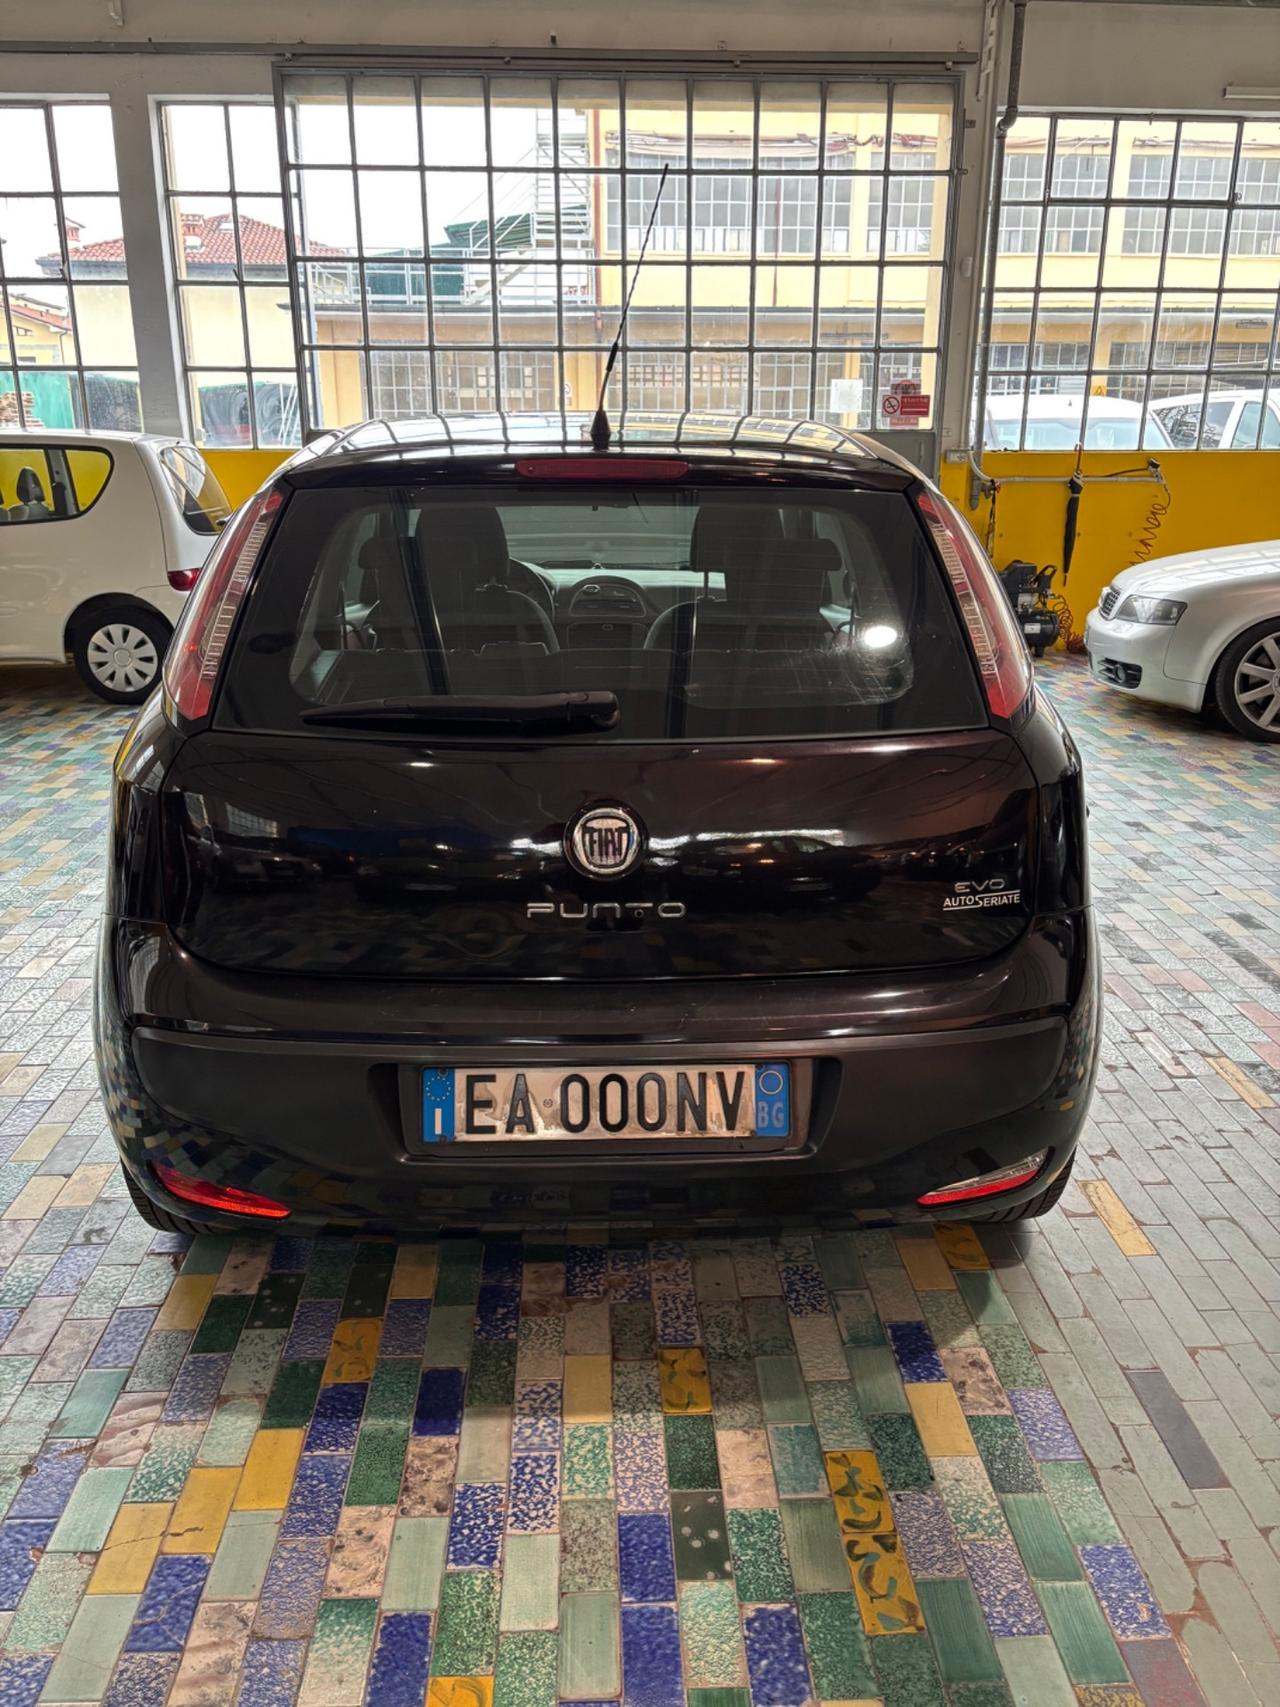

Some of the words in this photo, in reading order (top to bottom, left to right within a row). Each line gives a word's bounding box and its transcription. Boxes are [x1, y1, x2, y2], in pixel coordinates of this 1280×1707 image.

[583, 826, 629, 864] FIAT
[954, 879, 1005, 893] EVO
[527, 902, 686, 918] PUNTO
[466, 1074, 535, 1134] EA
[757, 1101, 785, 1128] BG
